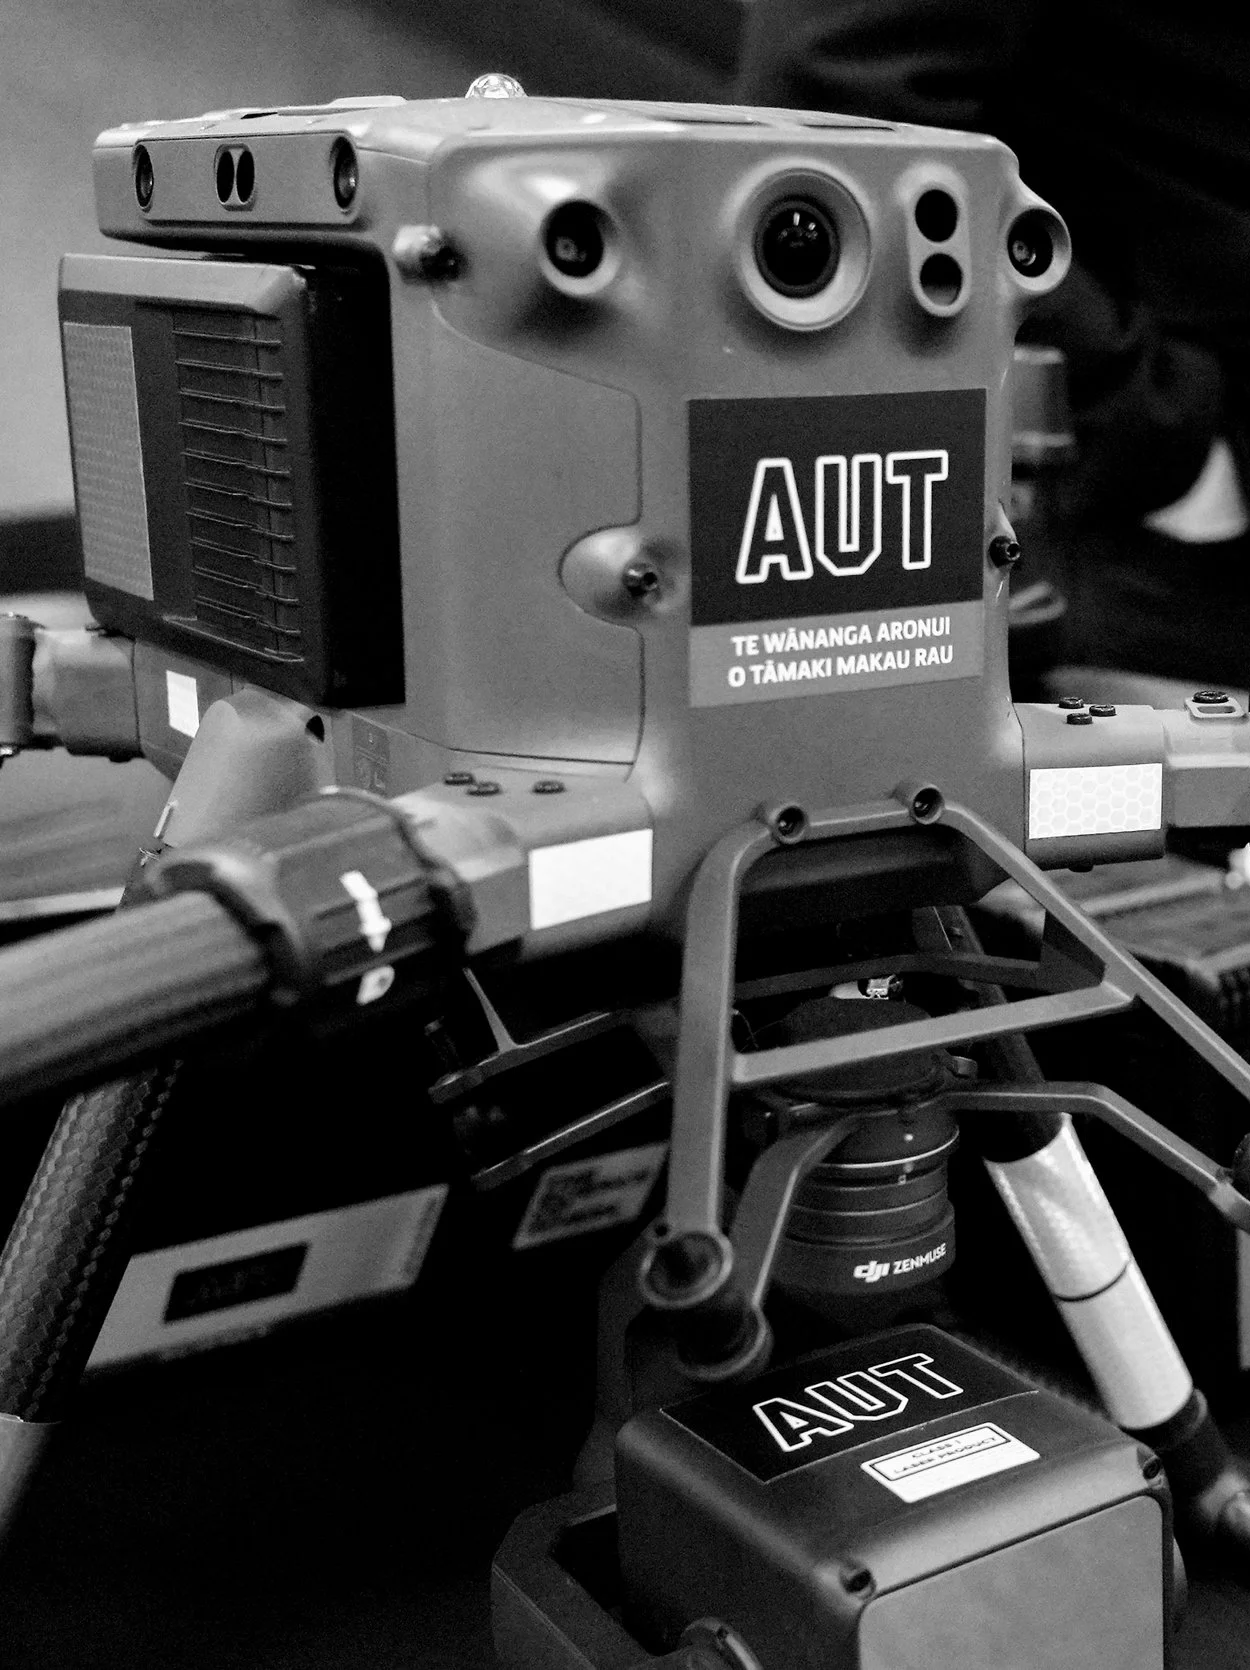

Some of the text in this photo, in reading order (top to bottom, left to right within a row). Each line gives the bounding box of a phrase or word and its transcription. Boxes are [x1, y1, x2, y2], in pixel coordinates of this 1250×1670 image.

[735, 449, 949, 585] AUT
[731, 616, 951, 657] TE WĀNANGA ARONUI
[727, 645, 954, 688] O TĀMAKI MAKAU RAU
[893, 1242, 946, 1274] ZENMUSE
[752, 1352, 964, 1453] AUT
[938, 1436, 996, 1459] PRODUCT
